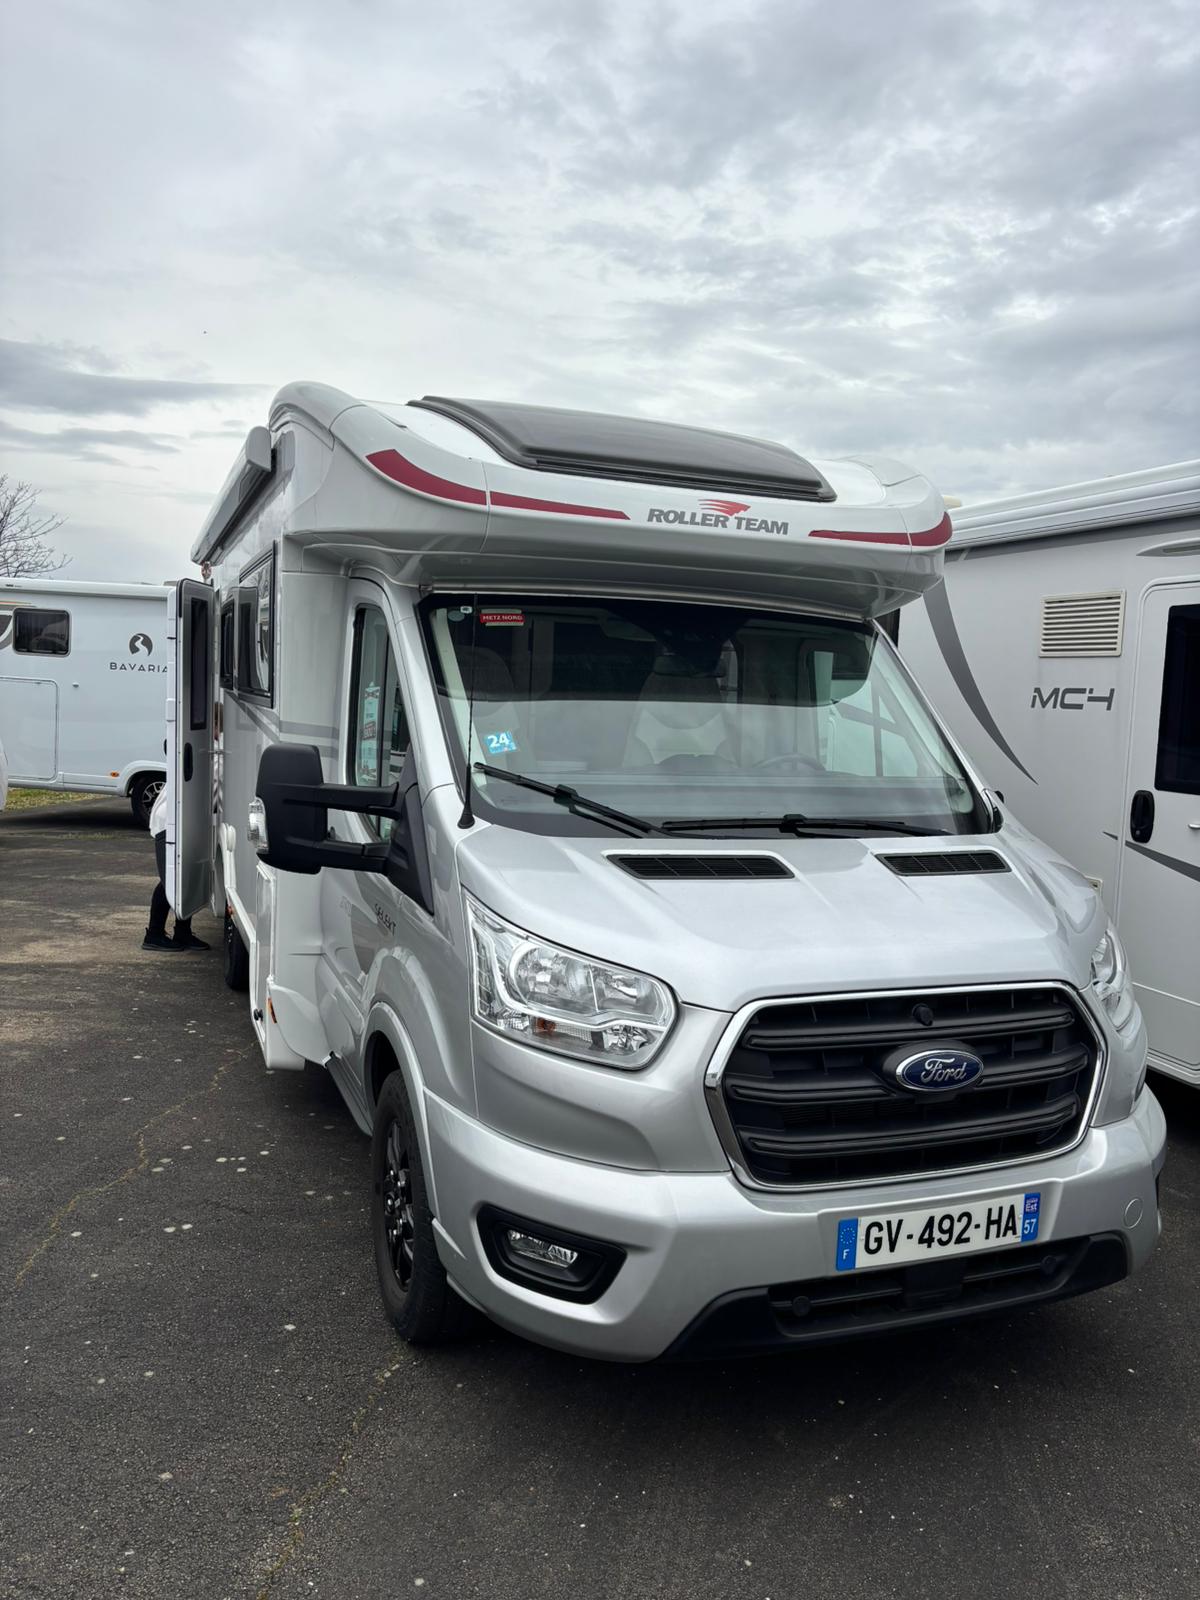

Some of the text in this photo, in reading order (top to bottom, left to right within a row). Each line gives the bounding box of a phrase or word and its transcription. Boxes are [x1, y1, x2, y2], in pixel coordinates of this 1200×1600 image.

[647, 508, 789, 535] ROLLER TEAM
[109, 662, 168, 673] BAVARIA
[1031, 687, 1115, 711] MC4
[487, 732, 510, 748] 24
[920, 1057, 967, 1084] Ford
[863, 1204, 1018, 1255] GV-492-HA
[1023, 1218, 1037, 1234] 57
[842, 1249, 850, 1260] F
